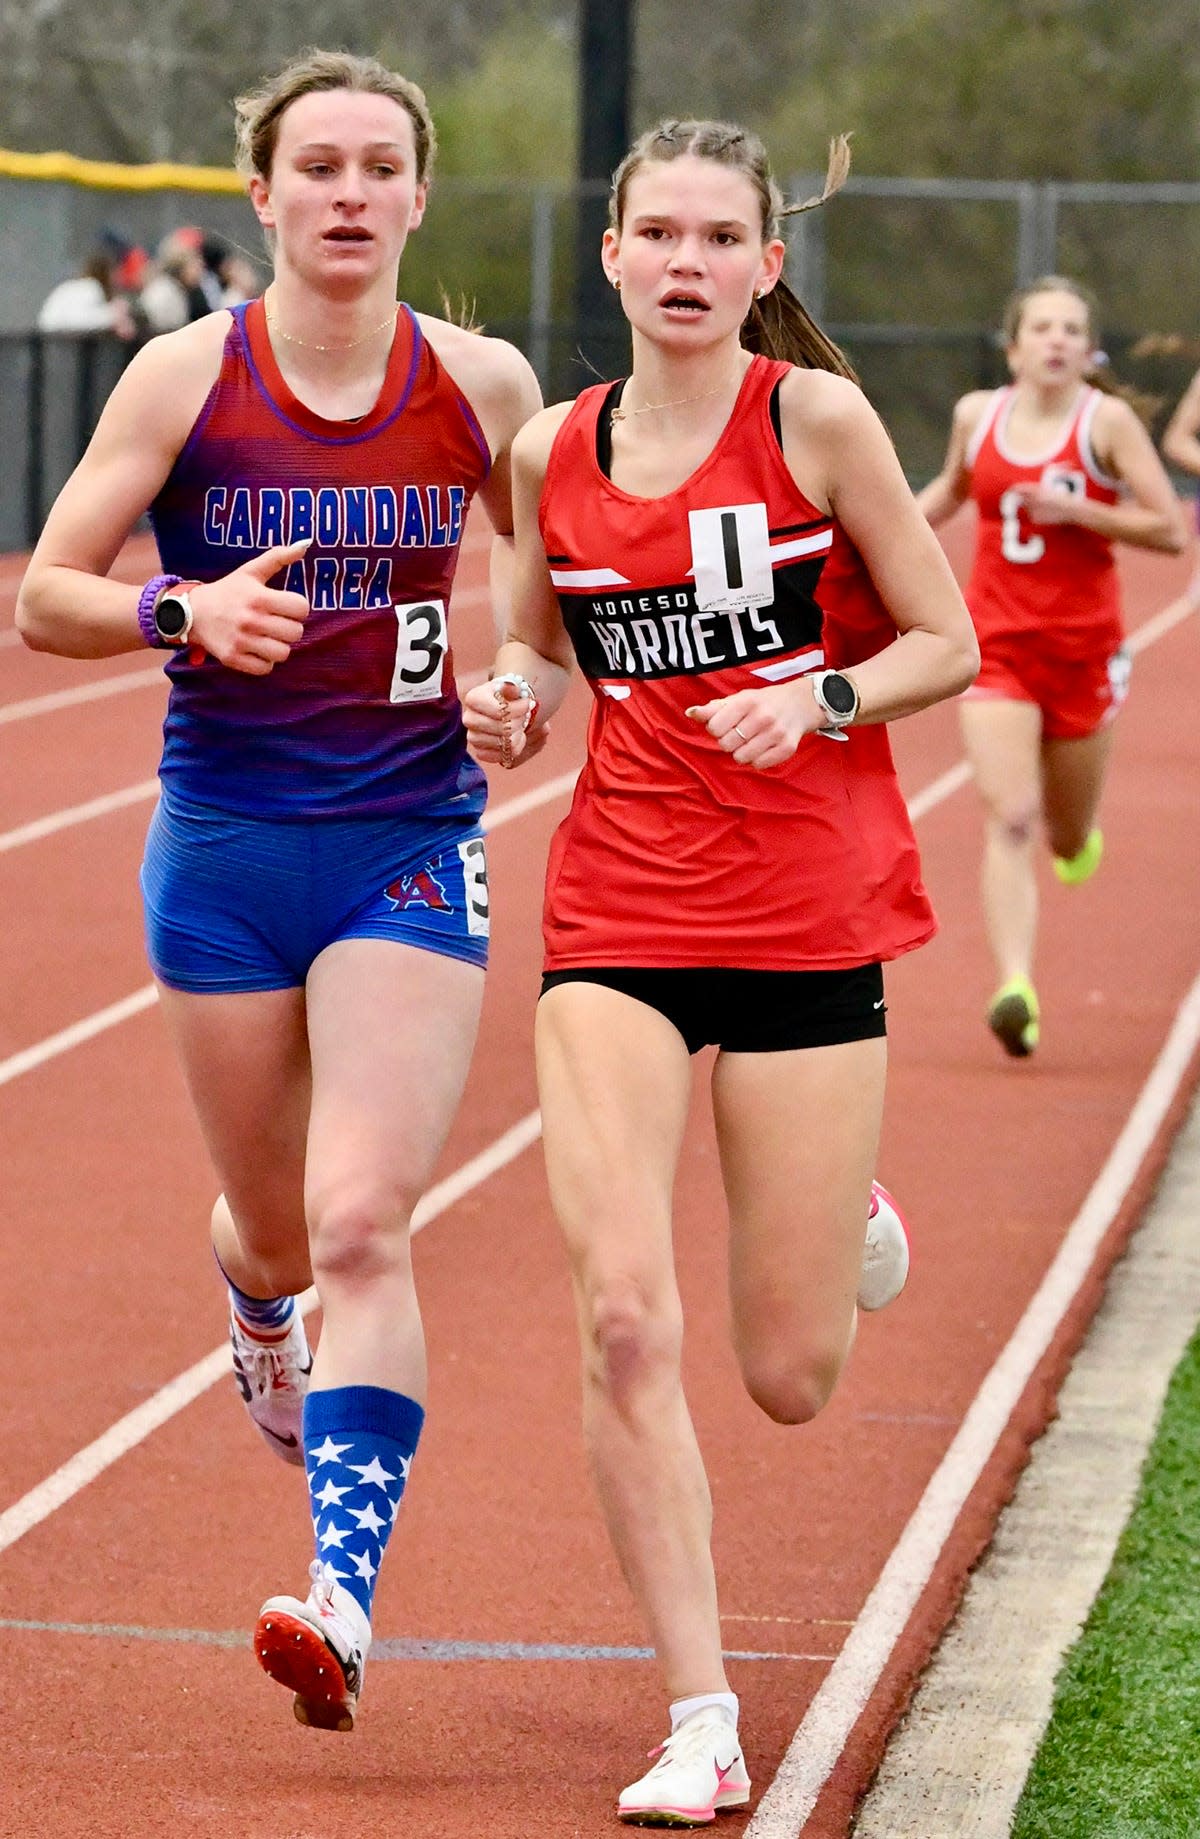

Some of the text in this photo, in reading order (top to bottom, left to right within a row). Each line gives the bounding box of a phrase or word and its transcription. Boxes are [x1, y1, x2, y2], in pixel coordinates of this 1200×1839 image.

[204, 486, 465, 549] CARBONDALE
[721, 512, 743, 590] 1
[284, 558, 392, 610] AREA
[592, 591, 700, 616] HONESD
[400, 605, 443, 684] 3
[588, 607, 785, 673] HORNETS
